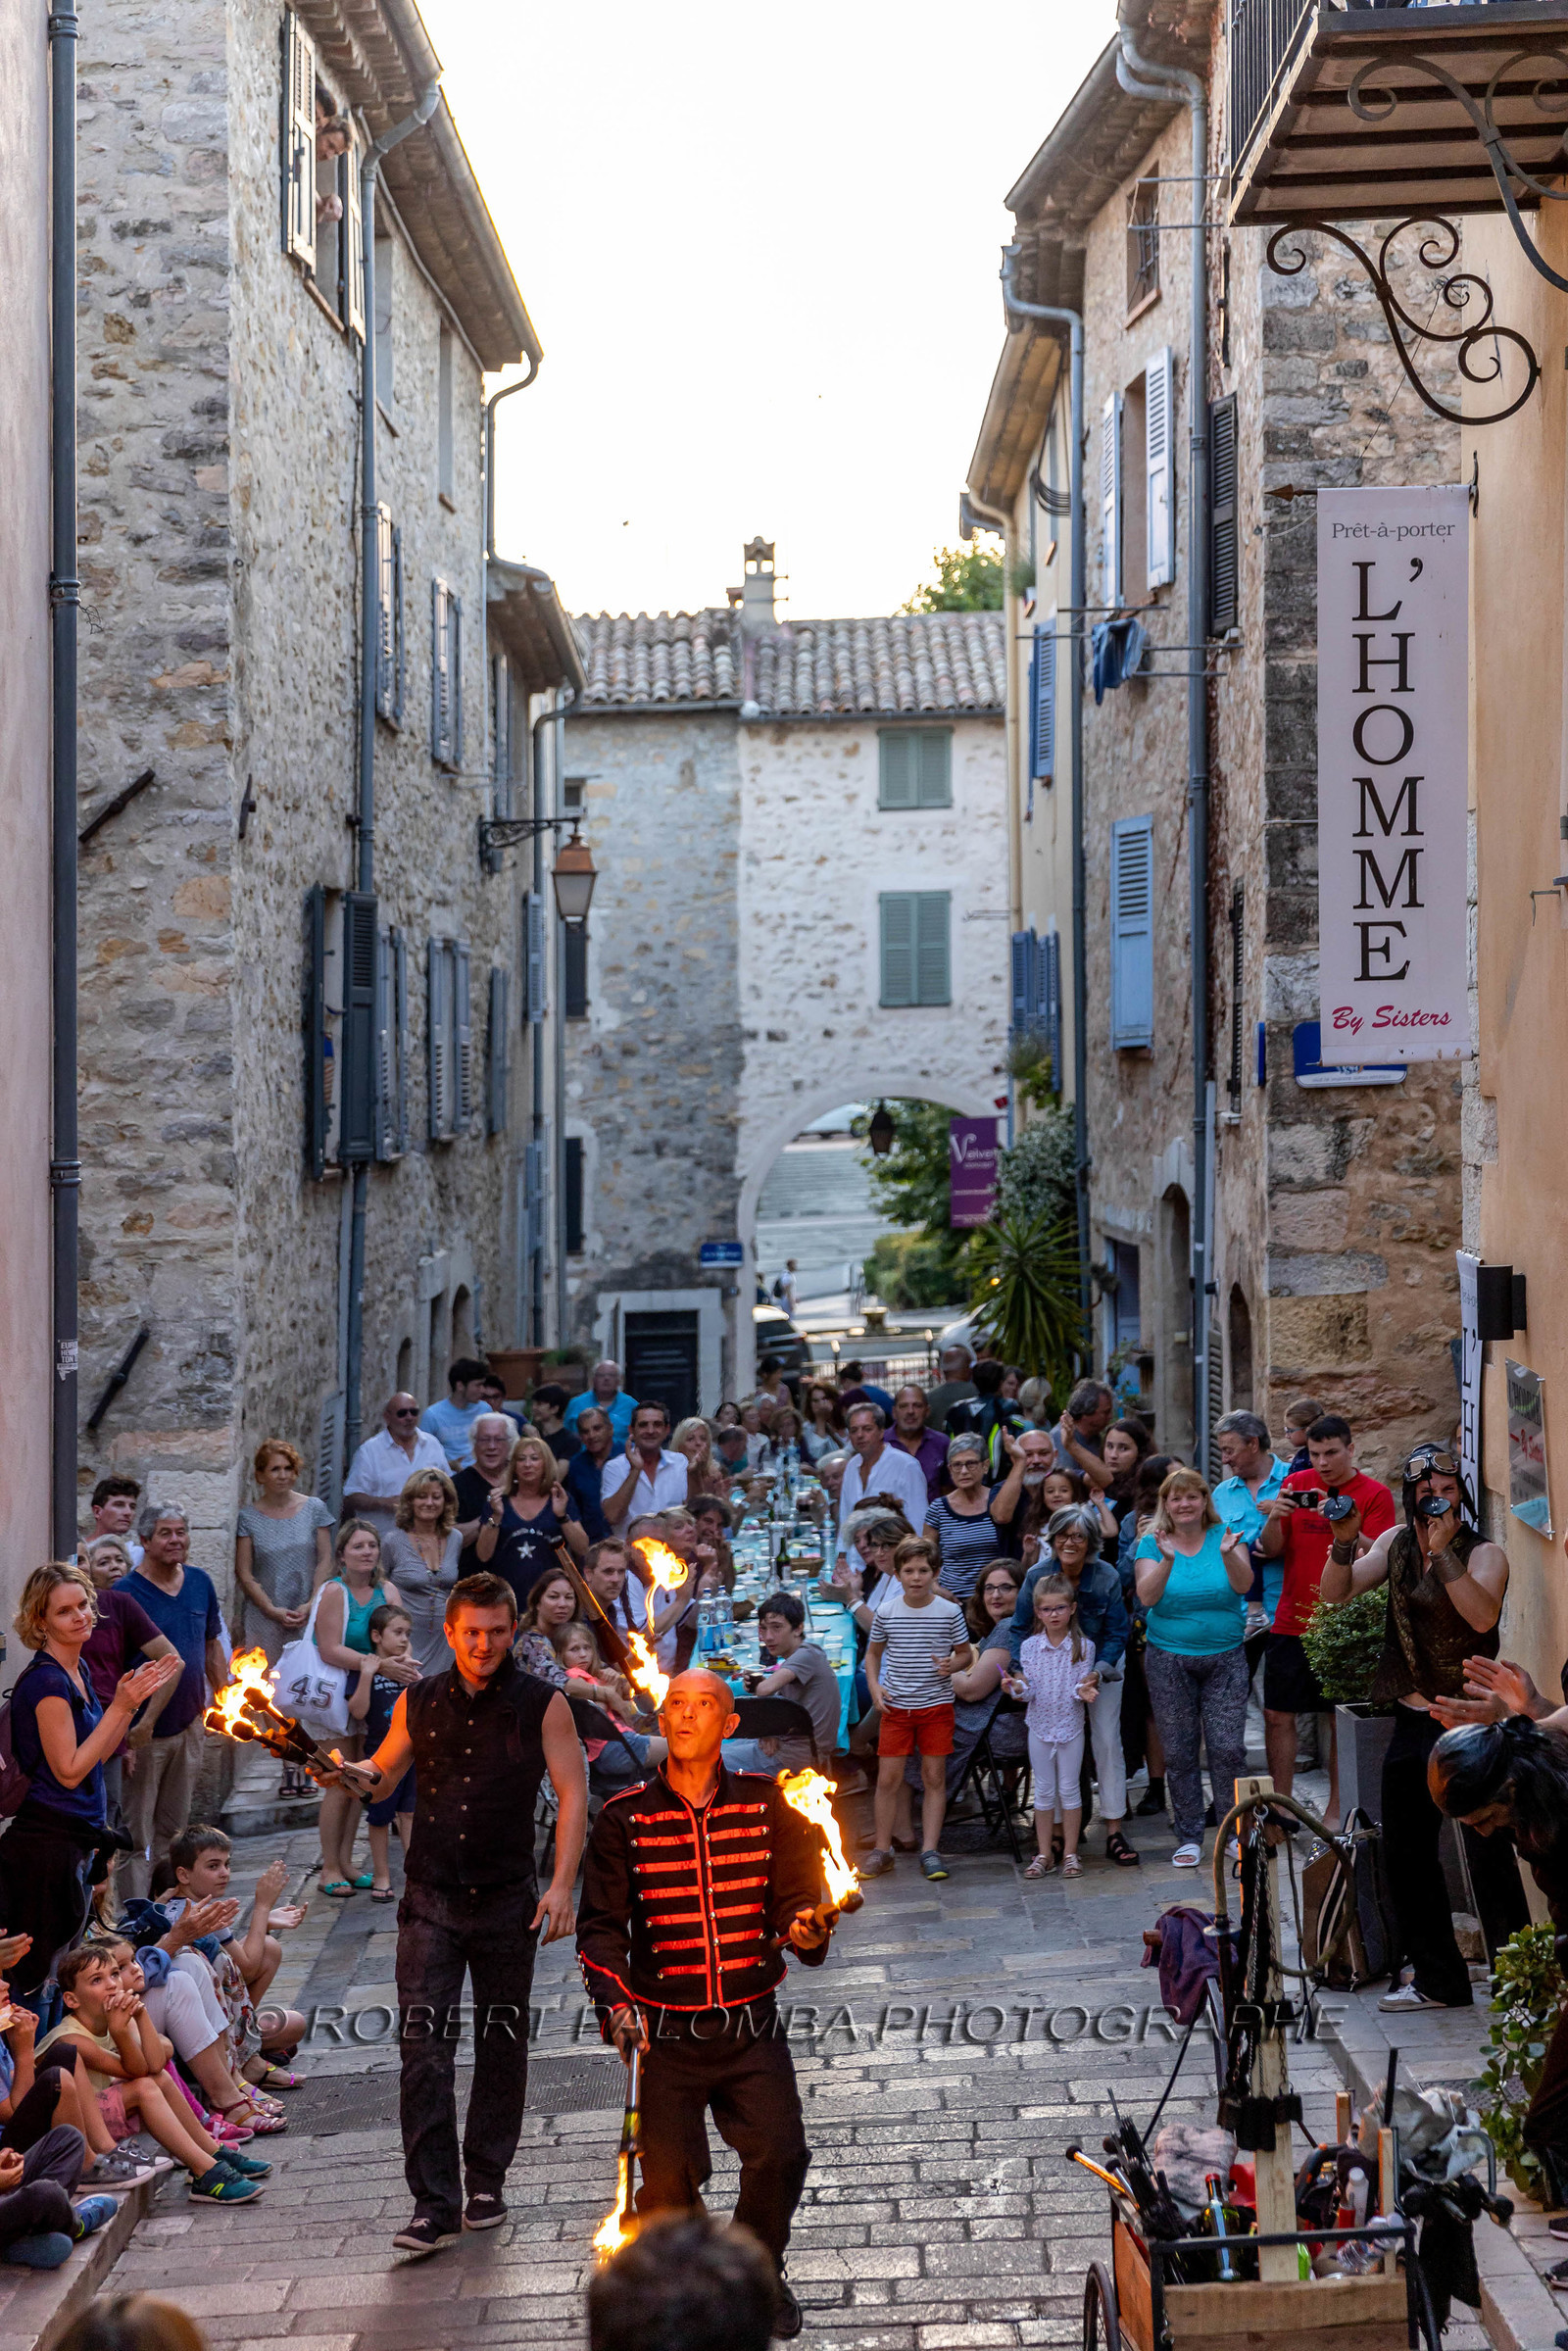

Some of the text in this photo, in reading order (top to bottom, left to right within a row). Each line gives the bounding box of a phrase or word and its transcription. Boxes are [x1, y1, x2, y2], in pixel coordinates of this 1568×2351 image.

[1332, 521, 1456, 542] Prêt-à-porter
[1332, 1004, 1452, 1036] By Sisters
[287, 1673, 338, 1711] 45
